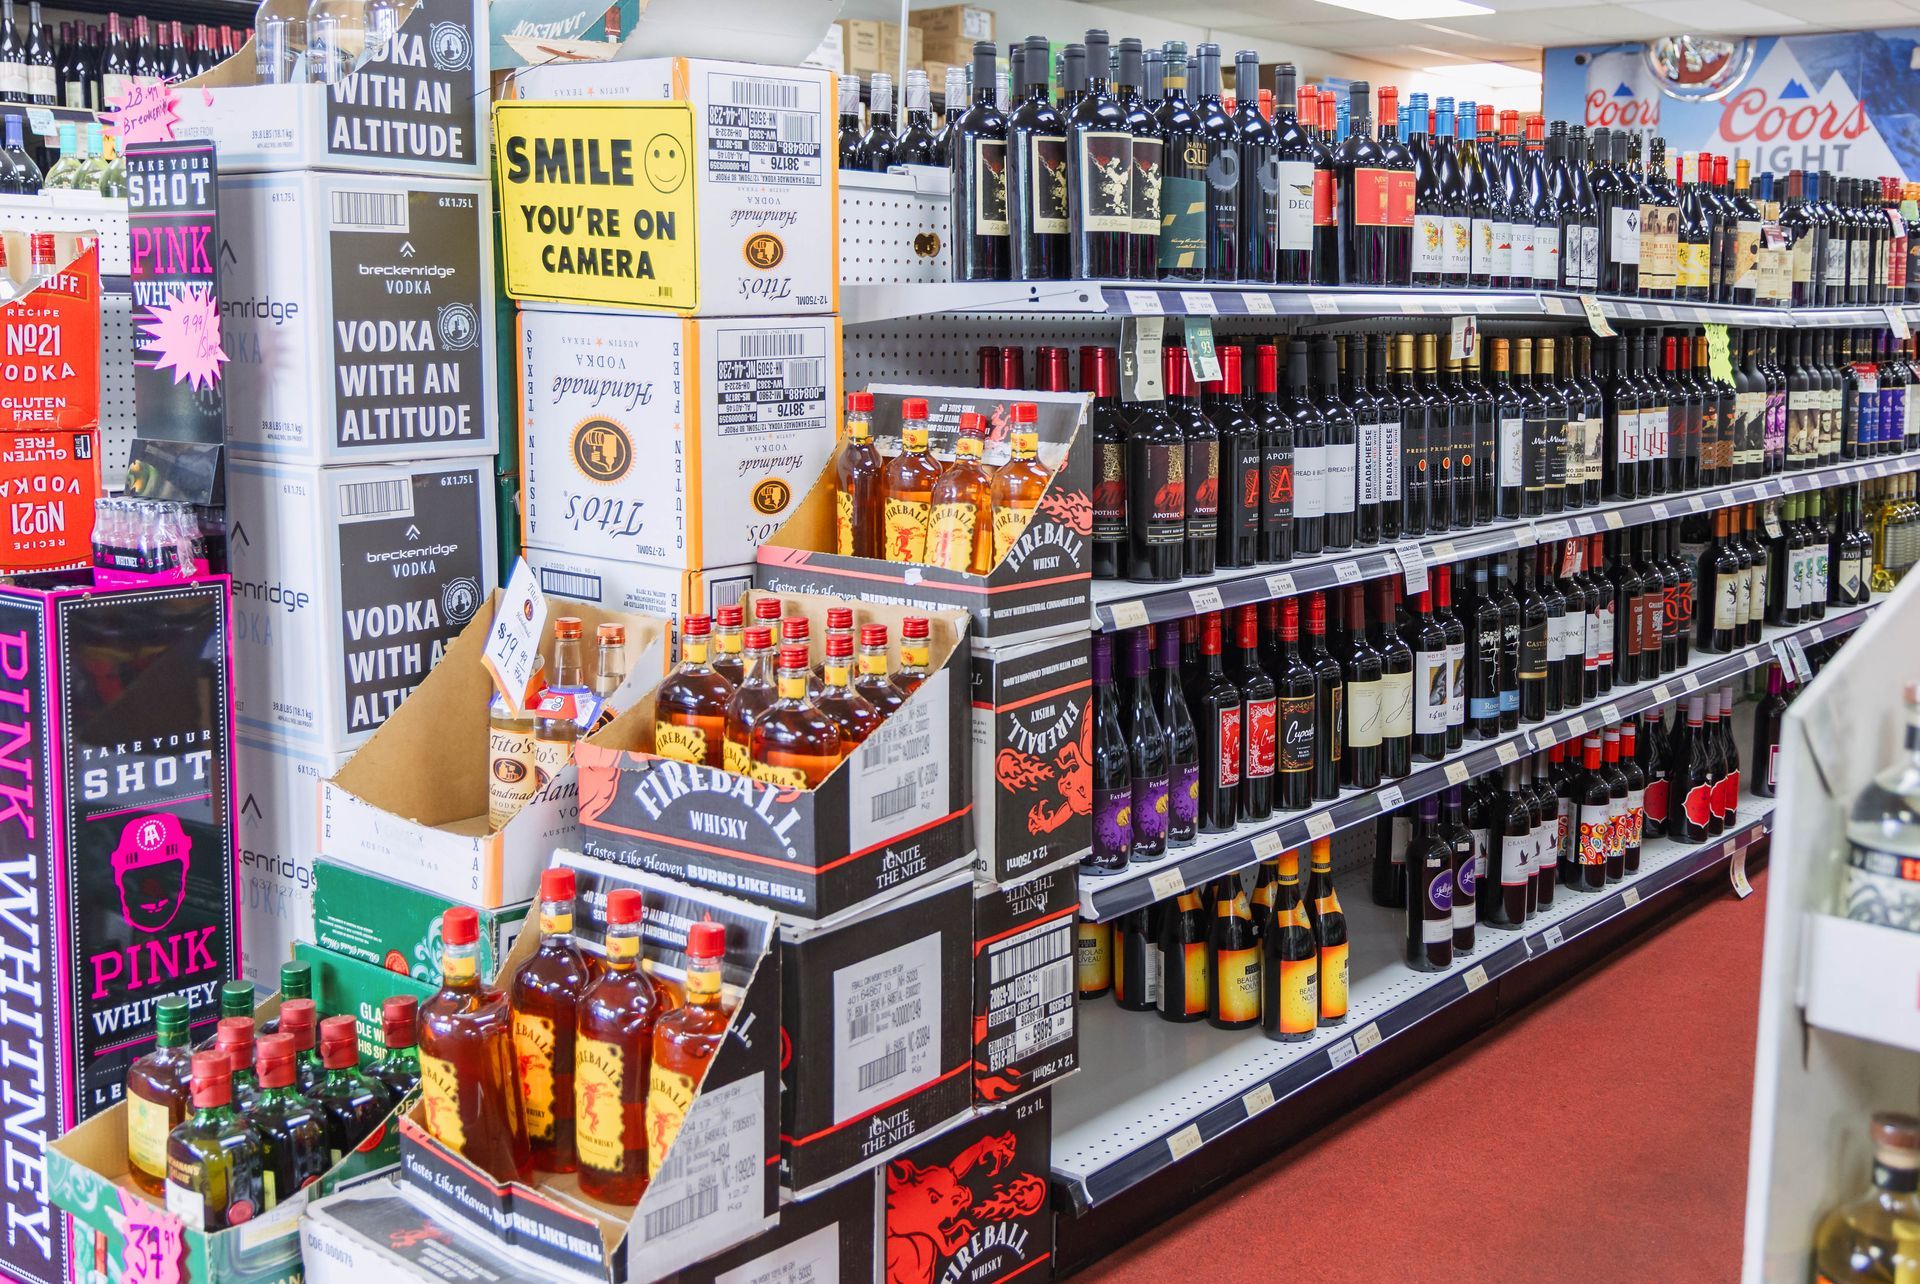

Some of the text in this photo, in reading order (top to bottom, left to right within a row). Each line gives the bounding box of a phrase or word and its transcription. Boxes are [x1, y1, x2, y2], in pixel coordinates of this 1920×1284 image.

[512, 11, 587, 41] JAMESON
[333, 73, 451, 114] WITH AN
[553, 87, 631, 96] AUSTIN TEXAS
[1585, 89, 1660, 128] Coors
[1718, 87, 1870, 143] Coors
[332, 116, 463, 158] ALTITUDE
[128, 157, 210, 172] TAKE YOUR
[506, 136, 634, 186] SMILE
[770, 157, 799, 171] 38176
[1734, 143, 1851, 174] LIGHT
[129, 172, 210, 207] SHOT
[746, 196, 781, 205] VODKA
[520, 205, 676, 240] YOU'RE ON
[730, 209, 798, 228] Handmade
[132, 226, 213, 274] PINK
[541, 244, 656, 280] CAMERA
[359, 264, 456, 278] breckenridge
[386, 280, 432, 295] VODKA
[739, 277, 792, 302] Tito's
[795, 295, 828, 305] 12-750ML
[7, 308, 60, 317] RECIPE
[337, 320, 435, 353] VODKA
[562, 336, 639, 348] AUSTIN TEXAS
[1200, 341, 1212, 354] 93
[0, 364, 76, 382] ODKA
[576, 353, 626, 369] VODKA
[339, 363, 460, 397] WITH AN
[1, 397, 66, 409] GLUTEN
[552, 376, 653, 412] Handmade
[13, 409, 54, 422] FREE
[342, 404, 472, 442] ALTITUDE
[777, 403, 805, 417] 38176
[3, 449, 67, 463] GLUTEN
[14, 437, 55, 448] FREE
[755, 444, 787, 453] VODKA
[738, 455, 804, 477] Handmade
[564, 494, 645, 539] Tito's
[885, 502, 926, 530] FIREBALL
[13, 539, 66, 550] RECIPE
[366, 543, 458, 563] breckenridge
[636, 544, 666, 557] 12-750ML
[1006, 522, 1083, 573] FIREBALL
[1842, 551, 1861, 559] TAYL
[393, 560, 436, 578] VODKA
[1033, 555, 1060, 571] WHISKY
[231, 580, 309, 612] enridge
[768, 577, 820, 596] Tastes Like
[346, 598, 440, 641] VODKA
[993, 608, 1014, 619] WHISKY
[1013, 606, 1026, 615] WITH
[1026, 602, 1047, 613] NATURAL
[1069, 595, 1086, 606] FLAVOR
[349, 643, 422, 683] WITH
[1030, 704, 1056, 723] WHISKY
[0, 630, 35, 840] PINK
[1007, 700, 1080, 755] FIREBALL
[83, 729, 211, 761] TAKE YOUR
[491, 734, 535, 754] Tito's
[656, 730, 701, 759] FIREBALL
[84, 750, 212, 800] SHOT
[635, 760, 801, 847] FIREBALL
[542, 825, 576, 838] AUSTIN
[690, 810, 748, 841] WHISKY
[882, 844, 921, 871] IGNITE
[1006, 844, 1048, 872] 12 x 750ml
[585, 840, 806, 903] Tastes Like Heaven, BURNS LIKE HELL
[876, 861, 928, 890] THE NITE
[1031, 875, 1054, 891] THE
[1012, 891, 1049, 915] IGNITE
[90, 925, 218, 1000] PINK
[0, 854, 51, 1261] WHITNEY
[1057, 1058, 1063, 1067] x
[1064, 1053, 1074, 1066] 12
[1032, 1063, 1057, 1083] 750ml
[1016, 1098, 1045, 1120] 12 x 1L
[869, 1108, 910, 1138] IGNITE
[862, 1120, 916, 1157] THE NITE
[406, 1154, 434, 1182] Tastes
[434, 1174, 453, 1194] Like
[454, 1186, 495, 1222] Heaven,
[538, 1222, 569, 1252] LIKE
[568, 1234, 602, 1262] HELL
[940, 1220, 1029, 1284] FIREBALL
[971, 1255, 1003, 1282] WHISKY
